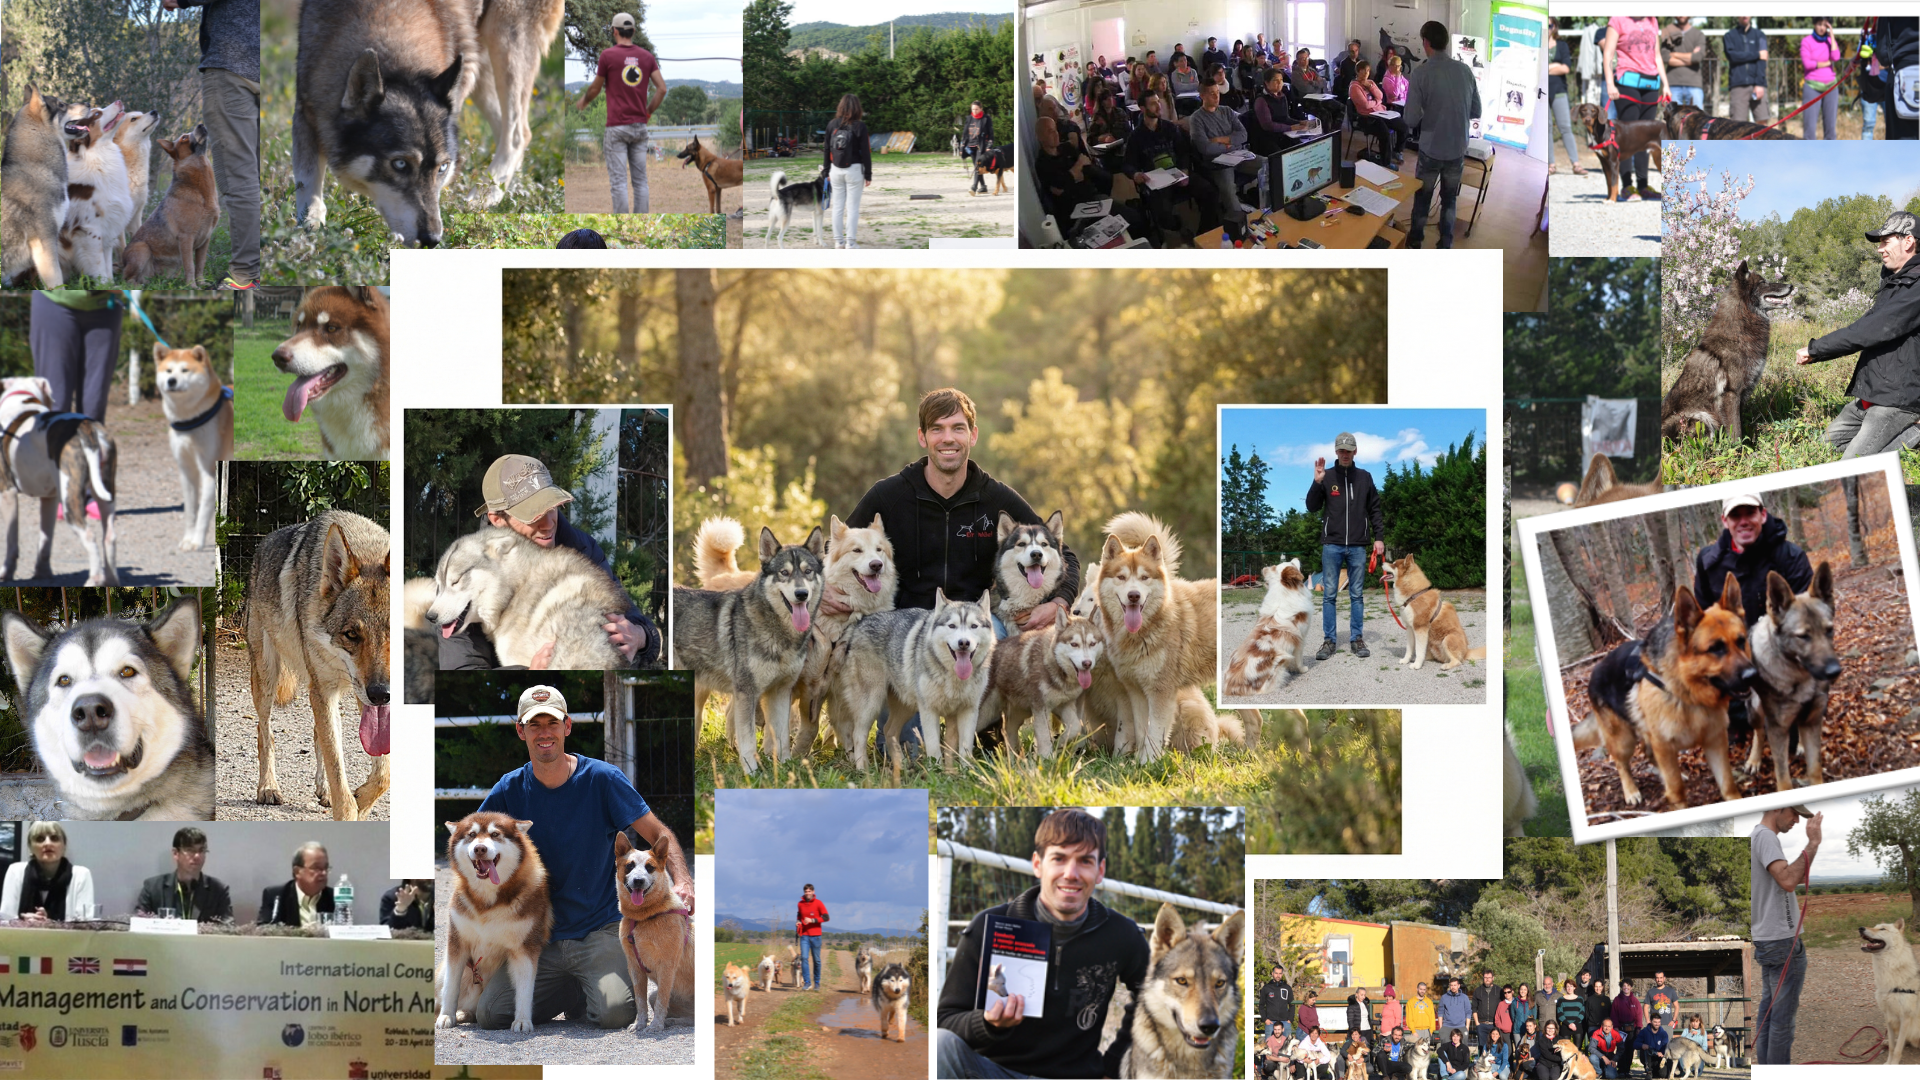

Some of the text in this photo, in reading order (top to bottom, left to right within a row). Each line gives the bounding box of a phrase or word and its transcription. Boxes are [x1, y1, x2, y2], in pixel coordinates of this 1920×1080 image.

[280, 960, 434, 983] International Cong
[0, 984, 146, 1015] Management
[150, 995, 177, 1010] and
[181, 987, 322, 1012] Conservation
[327, 997, 338, 1012] in
[343, 990, 402, 1013] North
[308, 1031, 362, 1040] lobo ibérico
[385, 1038, 395, 1046] 20
[410, 1039, 424, 1048] April
[370, 1069, 431, 1080] universidad
